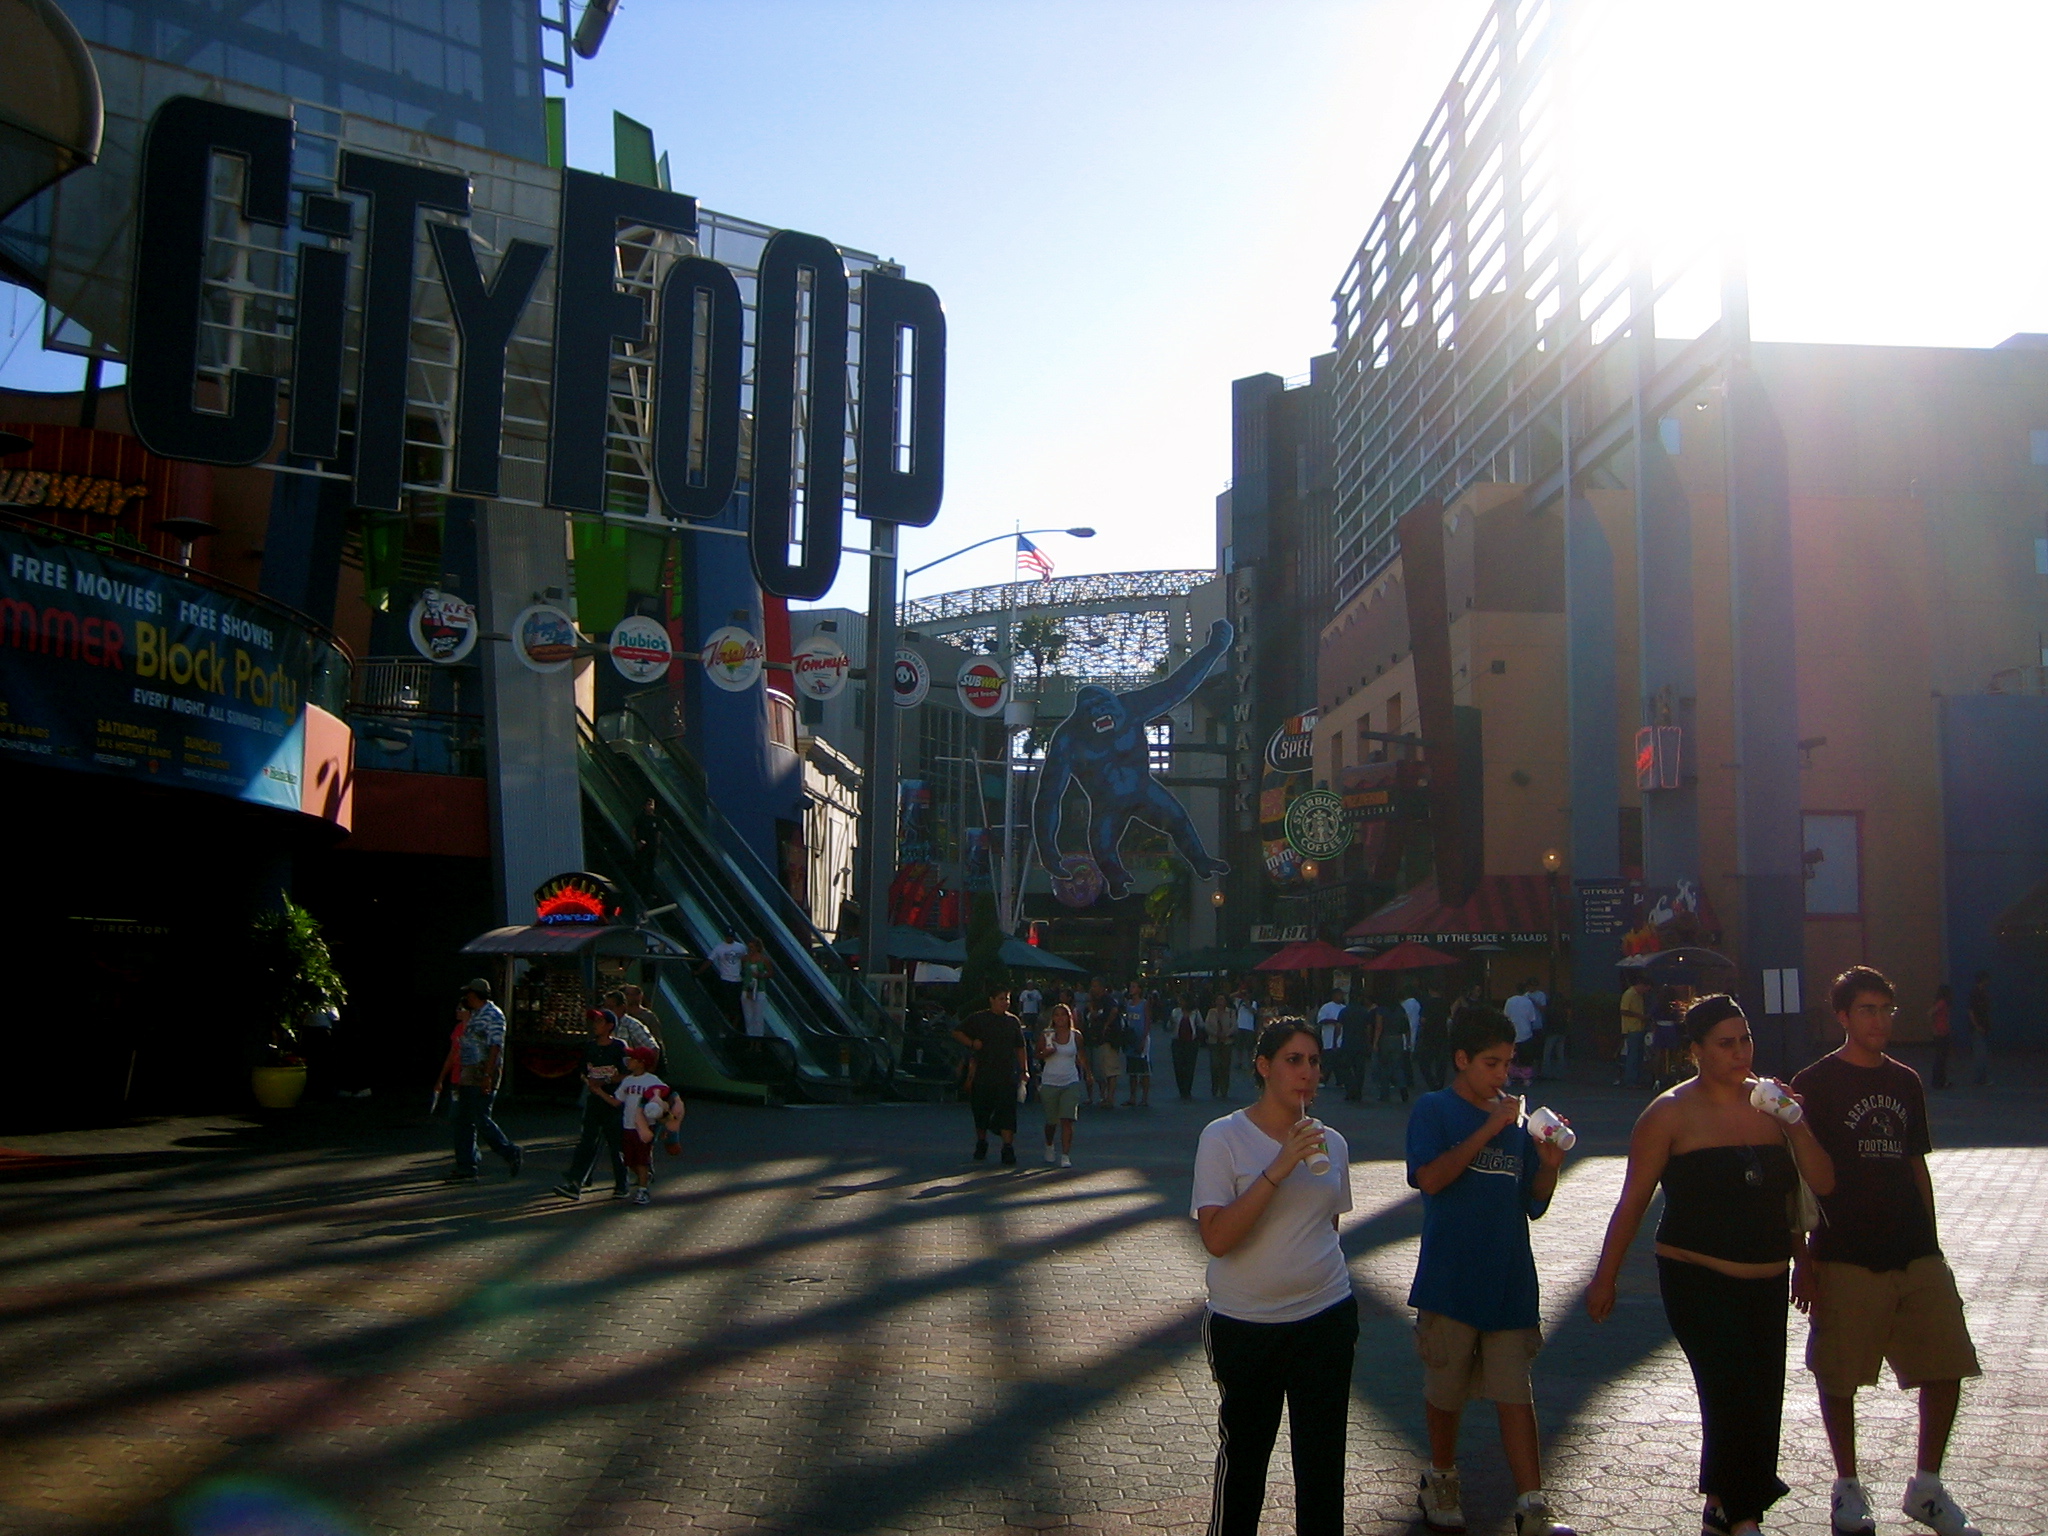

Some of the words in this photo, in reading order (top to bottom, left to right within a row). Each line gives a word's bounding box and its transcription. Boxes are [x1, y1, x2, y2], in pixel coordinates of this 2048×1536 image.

[11, 553, 68, 590] FREE
[75, 570, 163, 616] MOVIES!
[179, 600, 217, 632] FREE
[220, 613, 274, 651] SHOWS!
[443, 603, 476, 615] KFC
[618, 631, 667, 651] Rubio's
[135, 620, 227, 696] Block
[234, 647, 298, 727] Party
[791, 652, 850, 677] Tommy's
[960, 674, 1009, 690] SUBWAY
[133, 687, 170, 709] EVERY
[208, 705, 225, 722] ALL
[1232, 586, 1252, 812] CITYWALK
[1300, 836, 1343, 853] COFFEE
[92, 924, 171, 936] DIRECTORY
[1436, 934, 1450, 943] BY
[1451, 934, 1471, 943] THE
[1472, 934, 1499, 943] SLICE
[1511, 933, 1548, 943] SALADS
[1858, 1140, 1903, 1153] FOOTBALL
